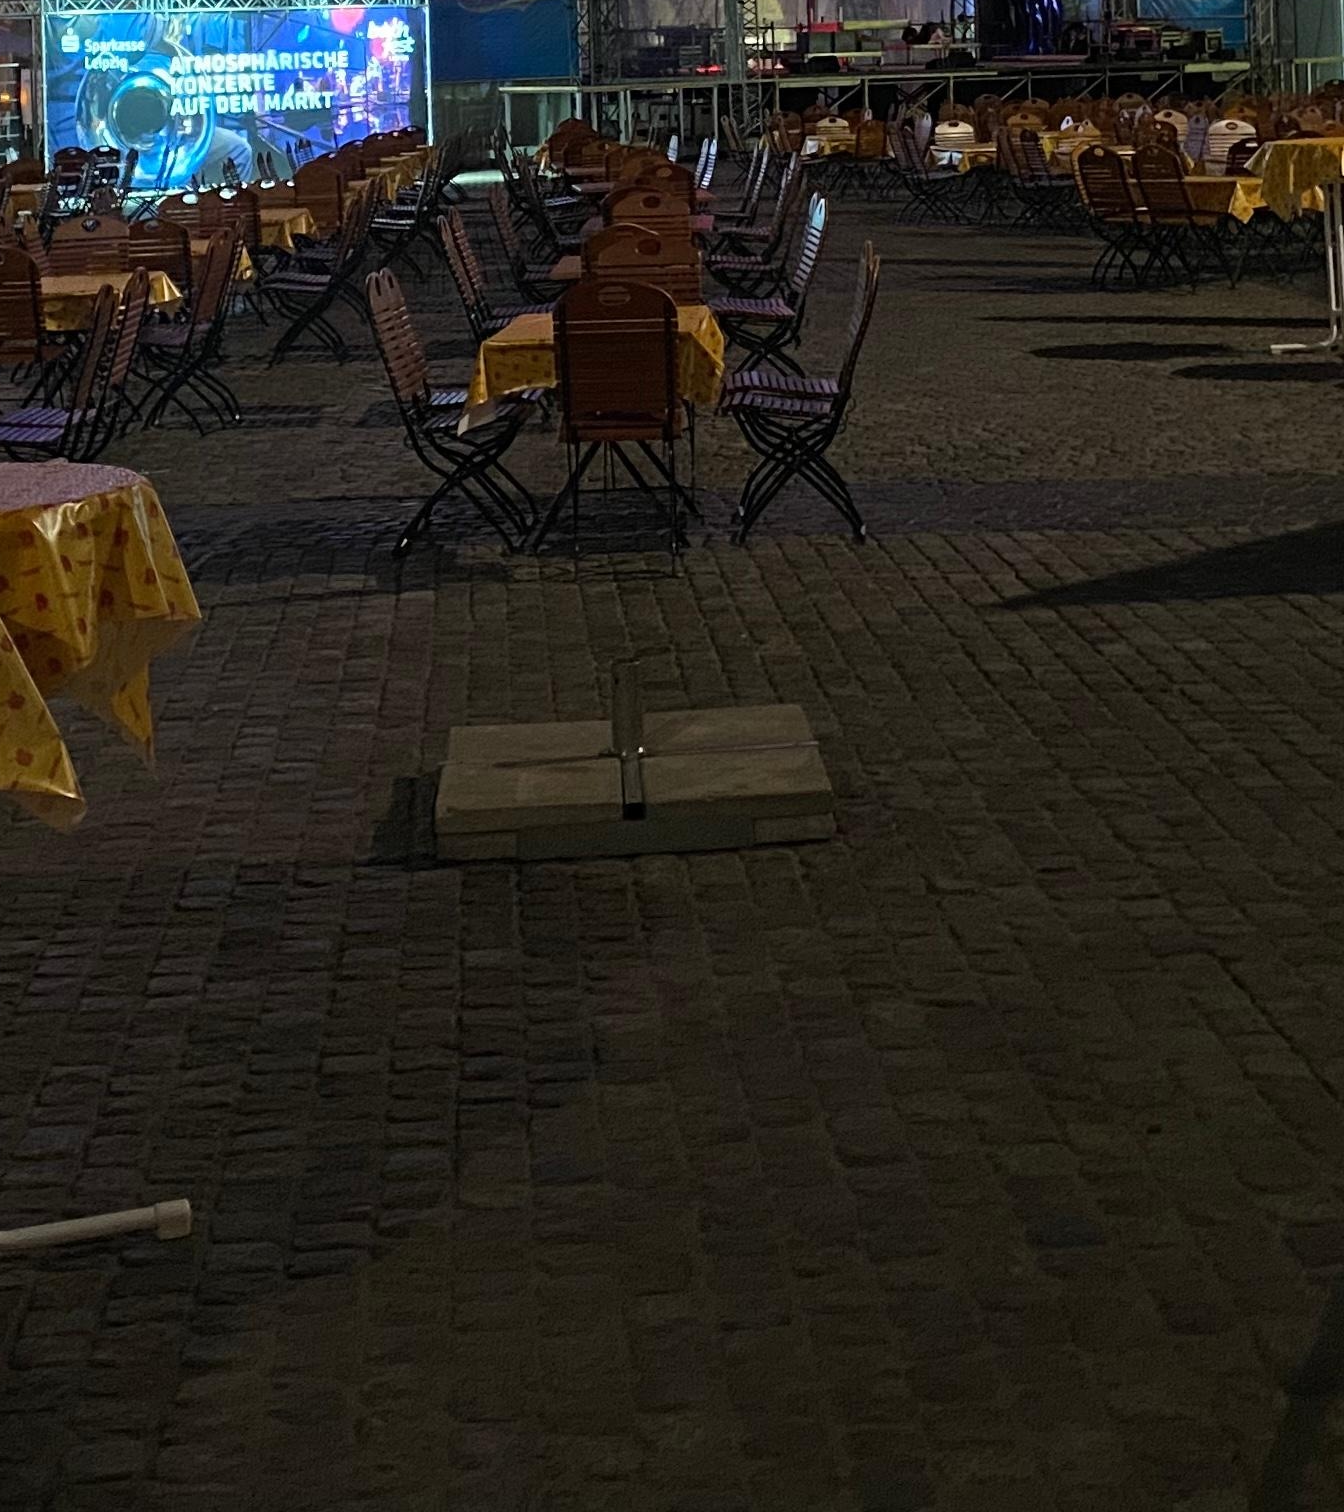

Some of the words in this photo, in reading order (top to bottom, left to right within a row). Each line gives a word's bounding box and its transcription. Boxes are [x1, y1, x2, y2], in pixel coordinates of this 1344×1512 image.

[84, 38, 146, 55] Sparkasse
[84, 55, 129, 73] Leipzig
[169, 49, 349, 75] ATMOSPHÄRISCHE
[170, 73, 276, 96] KONZERTE
[170, 96, 211, 116] AUF
[216, 94, 259, 114] DEM
[264, 91, 334, 111] MARKT
